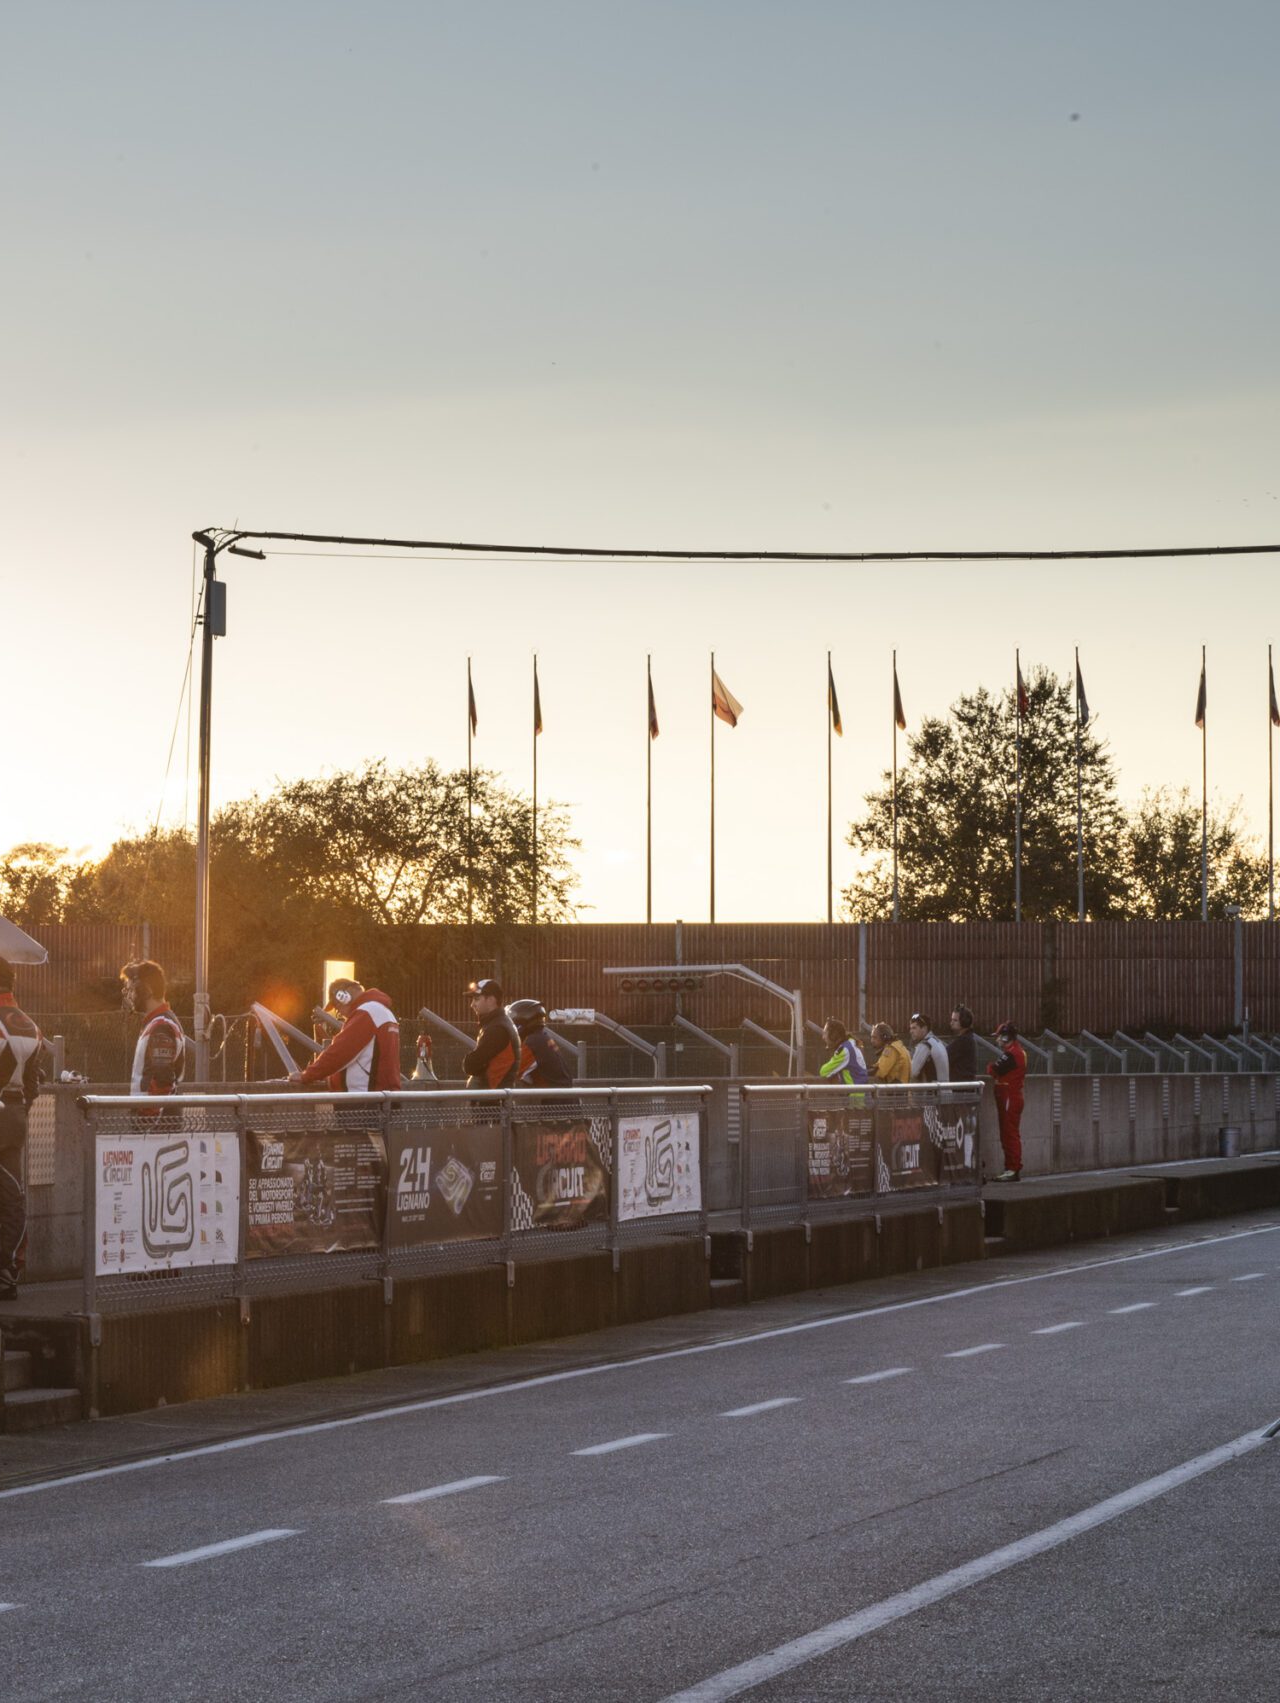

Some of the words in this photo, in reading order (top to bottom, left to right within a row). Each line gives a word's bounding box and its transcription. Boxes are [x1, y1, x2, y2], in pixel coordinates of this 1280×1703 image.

[536, 1132, 587, 1165] LIGNANO
[103, 1150, 134, 1166] LIGNANO
[103, 1165, 132, 1183] CIRCUIT
[398, 1147, 432, 1192] 24H
[248, 1178, 257, 1189] SEI
[257, 1177, 294, 1189] APPASSIONATO
[248, 1190, 258, 1201] DEL
[260, 1189, 294, 1200] MOTORSPORT
[396, 1192, 431, 1211] LIGNANO
[253, 1201, 275, 1213] VORRESTI
[255, 1213, 271, 1225] PRIMA
[271, 1212, 294, 1224] PERSONA
